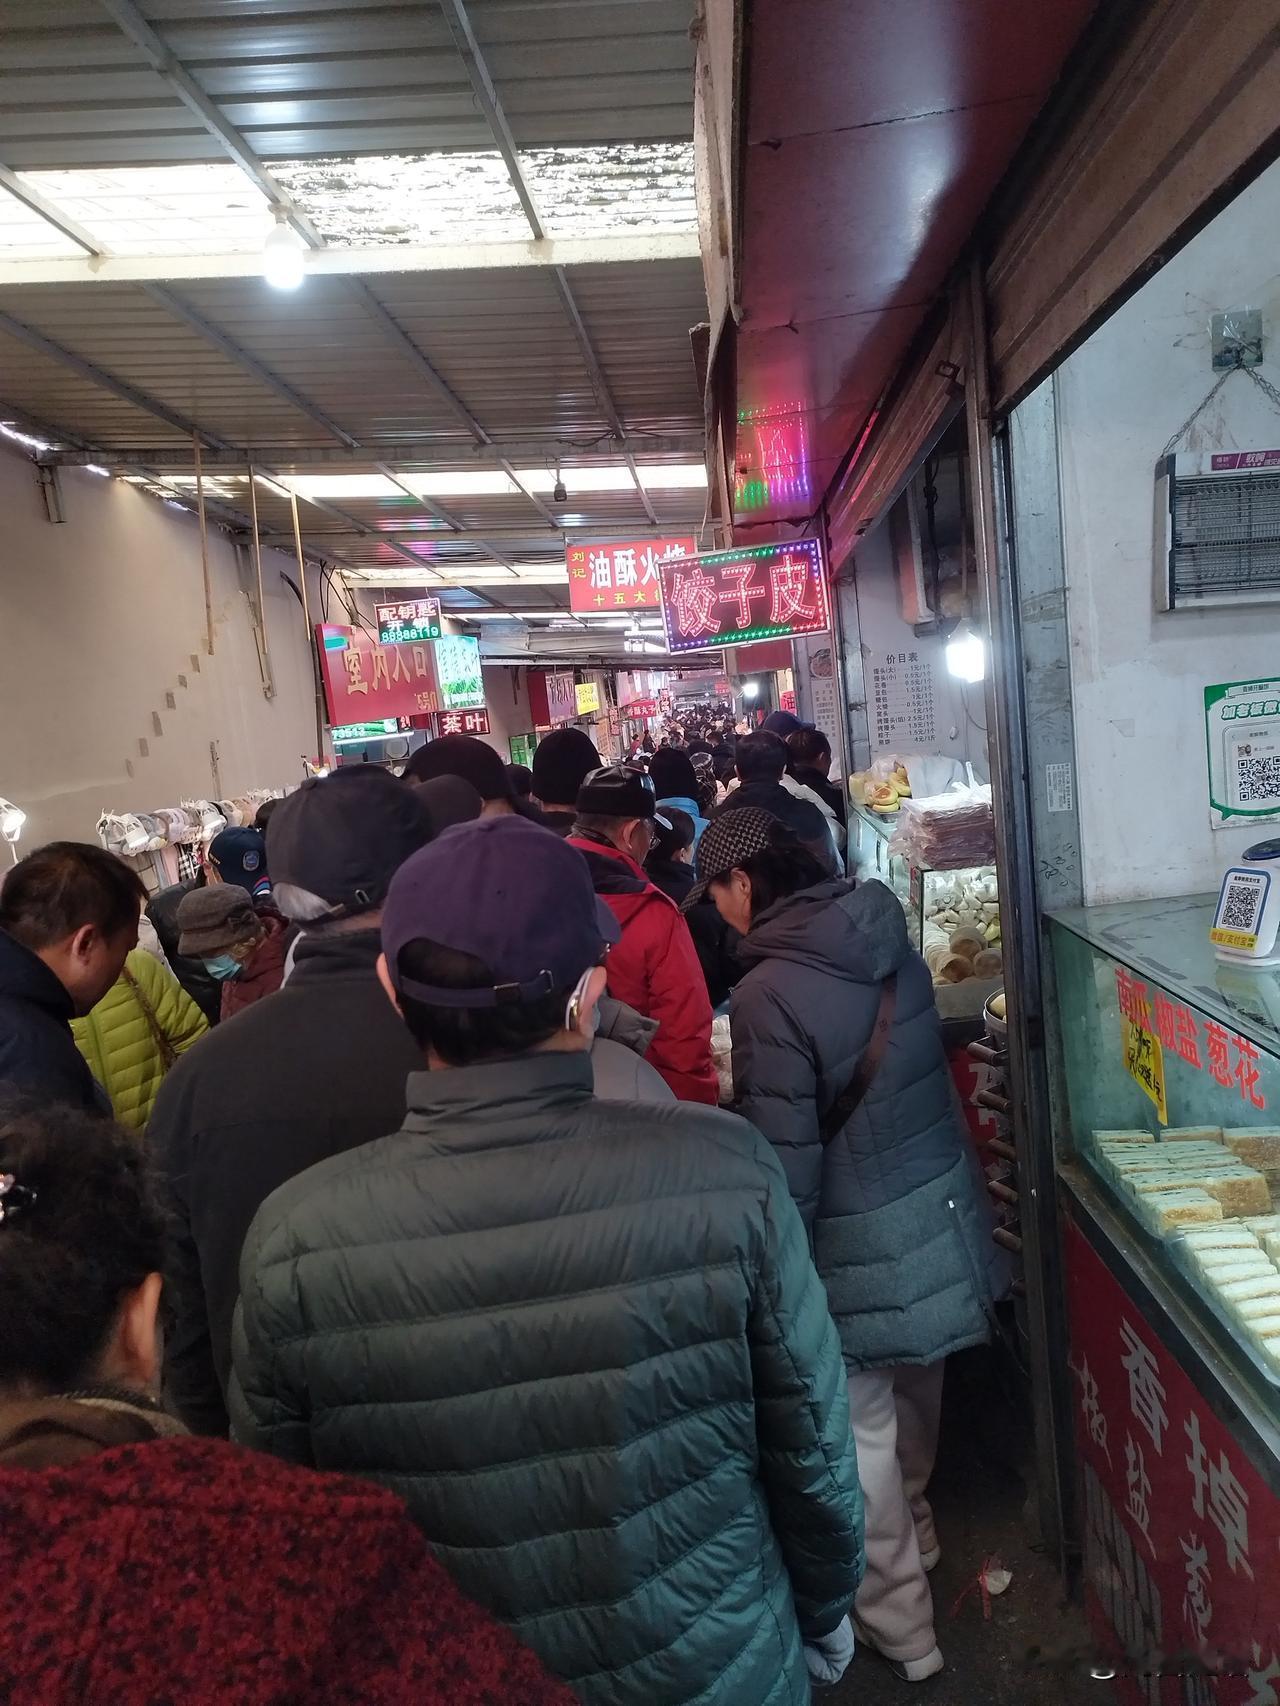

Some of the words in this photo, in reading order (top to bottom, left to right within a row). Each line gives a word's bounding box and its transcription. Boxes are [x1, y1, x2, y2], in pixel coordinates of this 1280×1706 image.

[571, 551, 587, 579] 刘记
[594, 590, 660, 607] 十五大
[671, 554, 816, 637] 饺子皮
[378, 600, 437, 622] 配钥匙
[343, 640, 426, 695] 室内入口
[886, 652, 918, 664] 价目表
[1221, 700, 1280, 720] 加老板微
[442, 713, 484, 735] 茶叶
